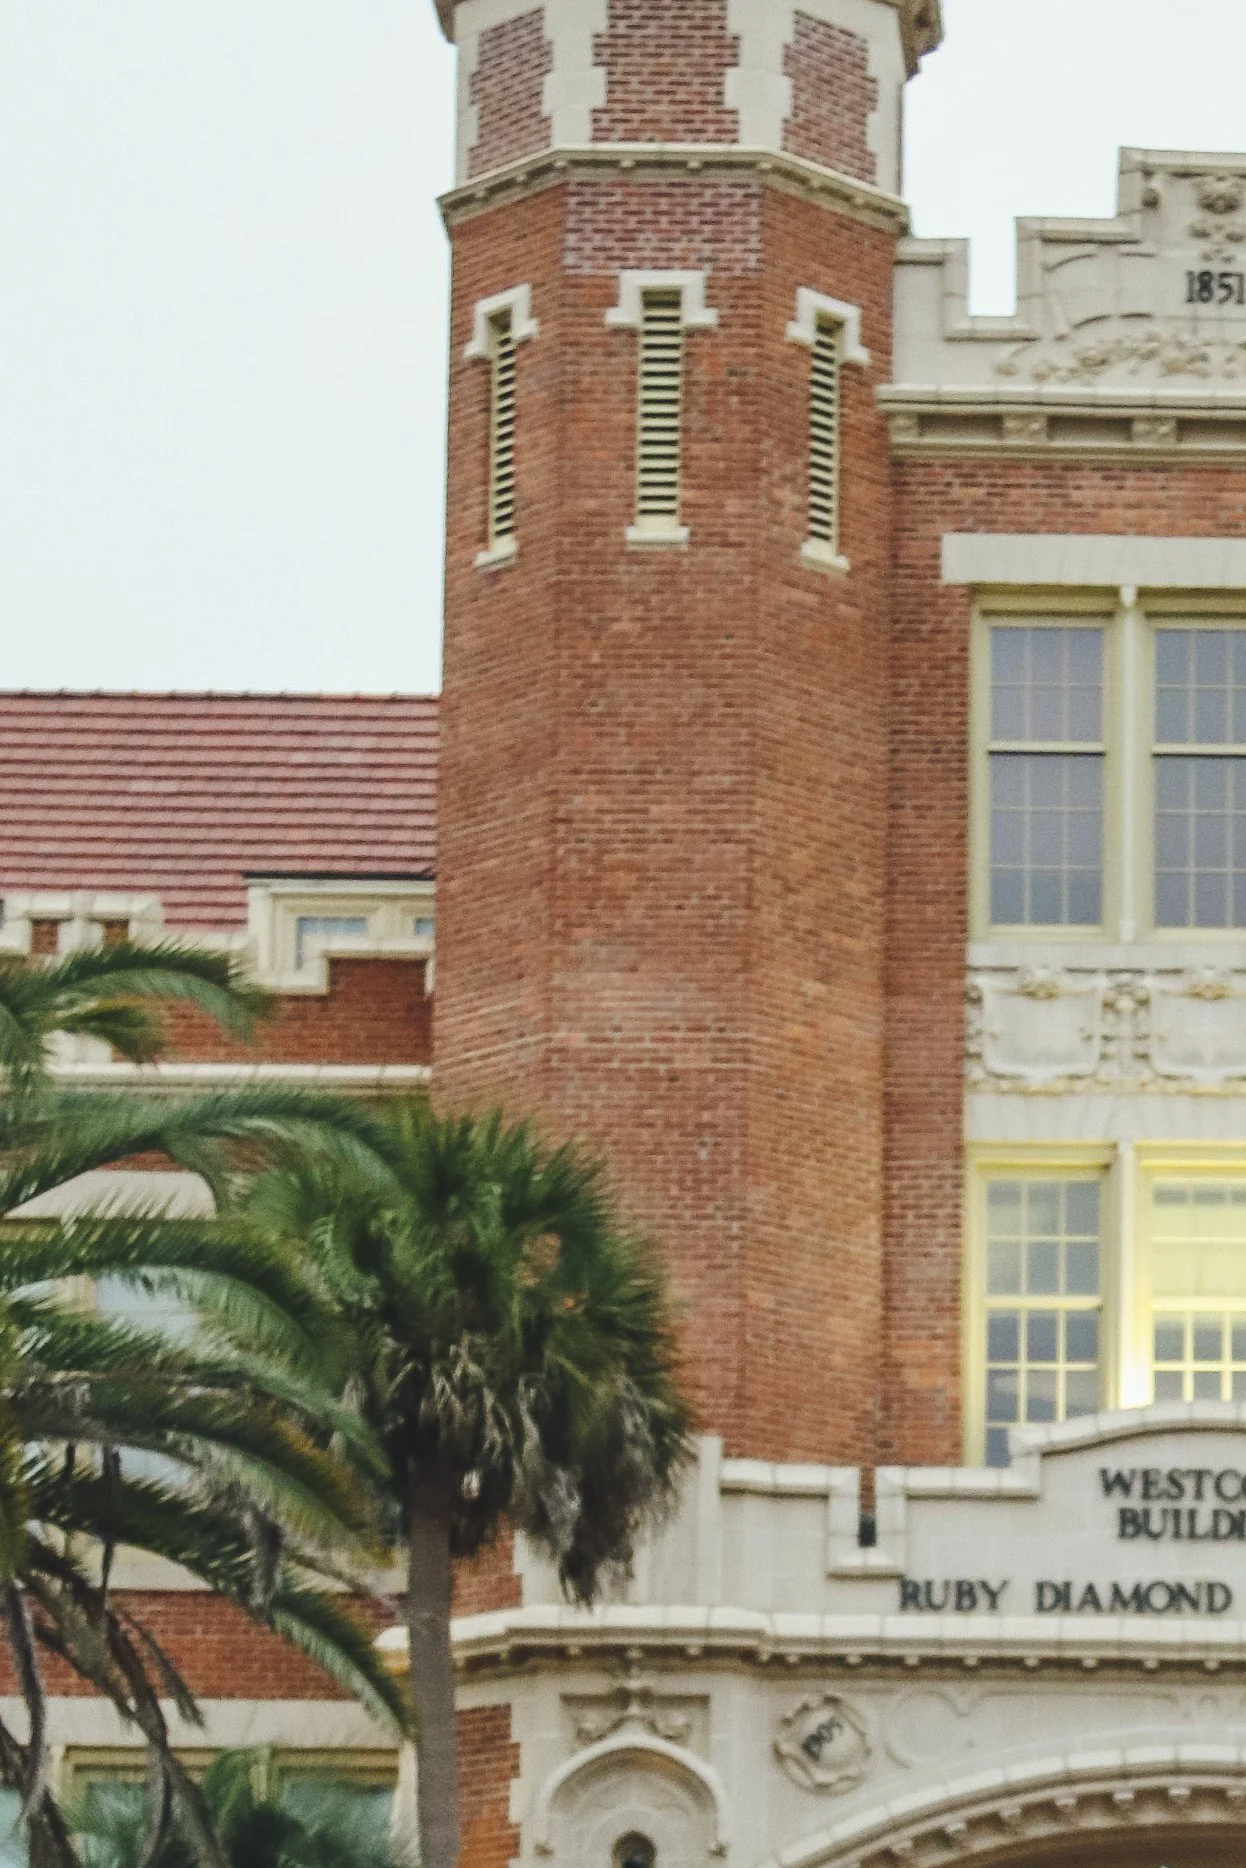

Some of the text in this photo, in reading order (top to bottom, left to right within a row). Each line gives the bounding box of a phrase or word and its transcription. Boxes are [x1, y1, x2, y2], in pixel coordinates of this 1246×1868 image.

[1185, 269, 1246, 305] 1851
[900, 1579, 1010, 1613] RUBY
[1035, 1580, 1233, 1615] DIAMOND
